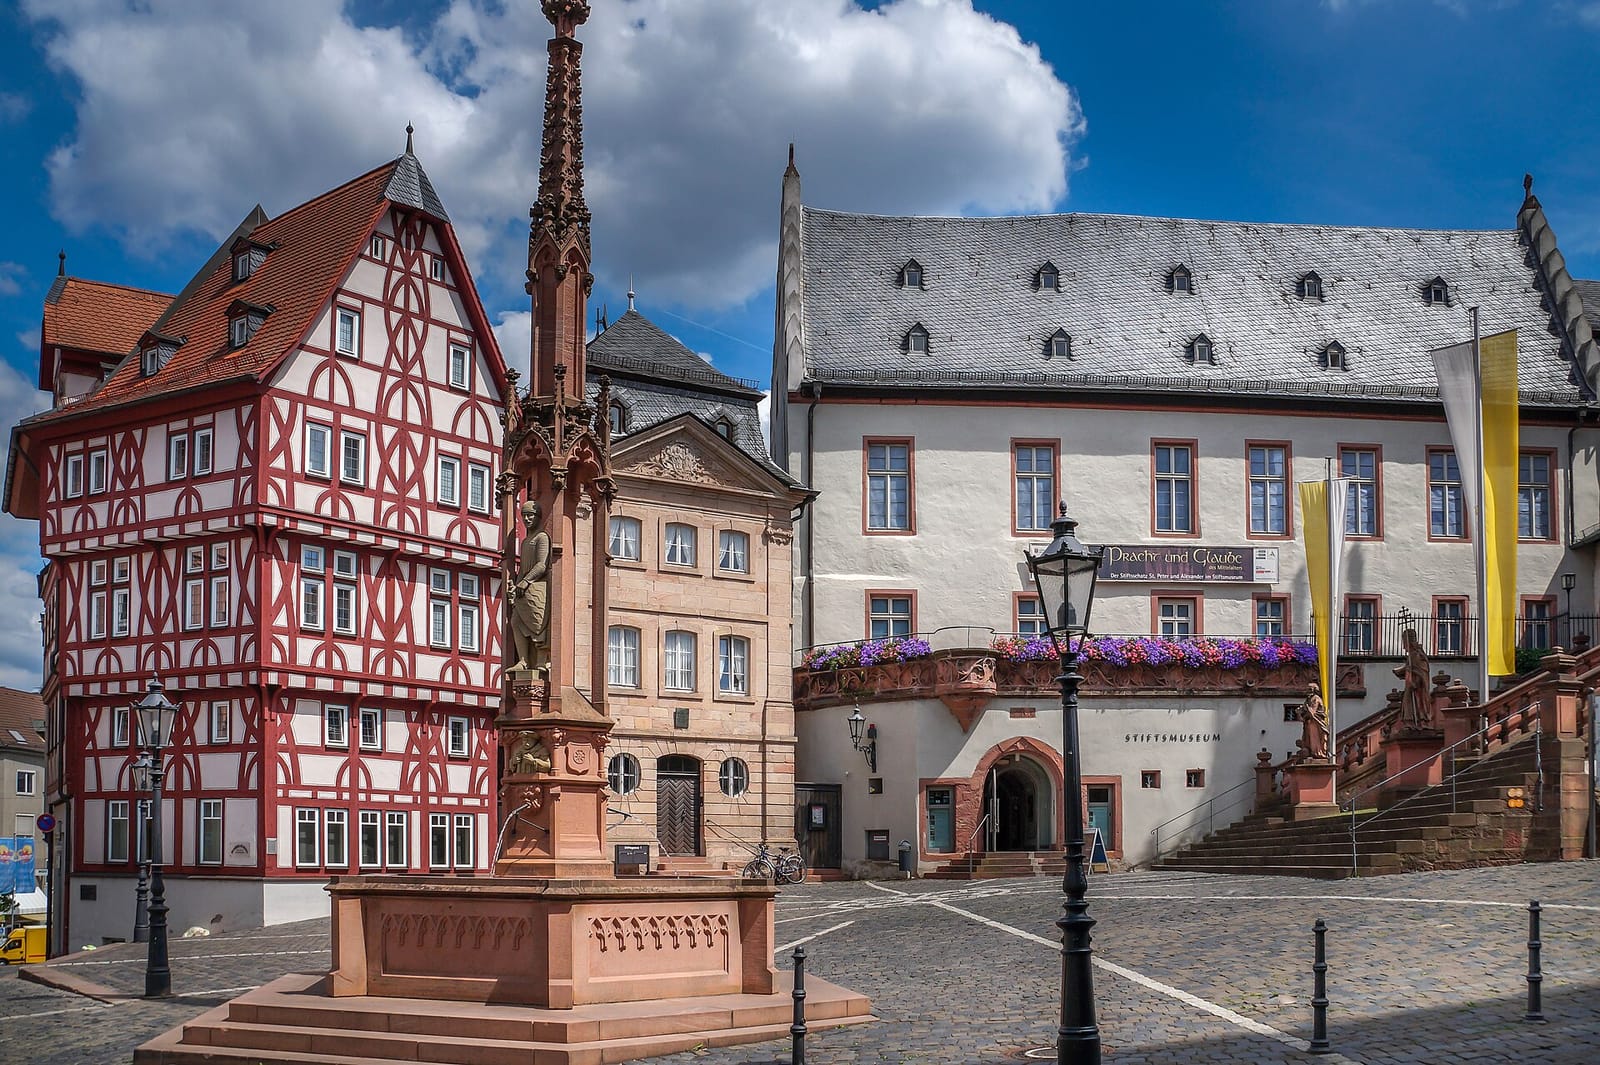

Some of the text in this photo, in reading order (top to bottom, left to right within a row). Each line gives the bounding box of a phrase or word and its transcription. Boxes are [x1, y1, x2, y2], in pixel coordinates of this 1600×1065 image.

[1108, 546, 1161, 567] Pracht
[1164, 550, 1189, 563] und
[1193, 548, 1243, 567] Glaube
[1124, 733, 1221, 743] STIFTSMUSEUM
